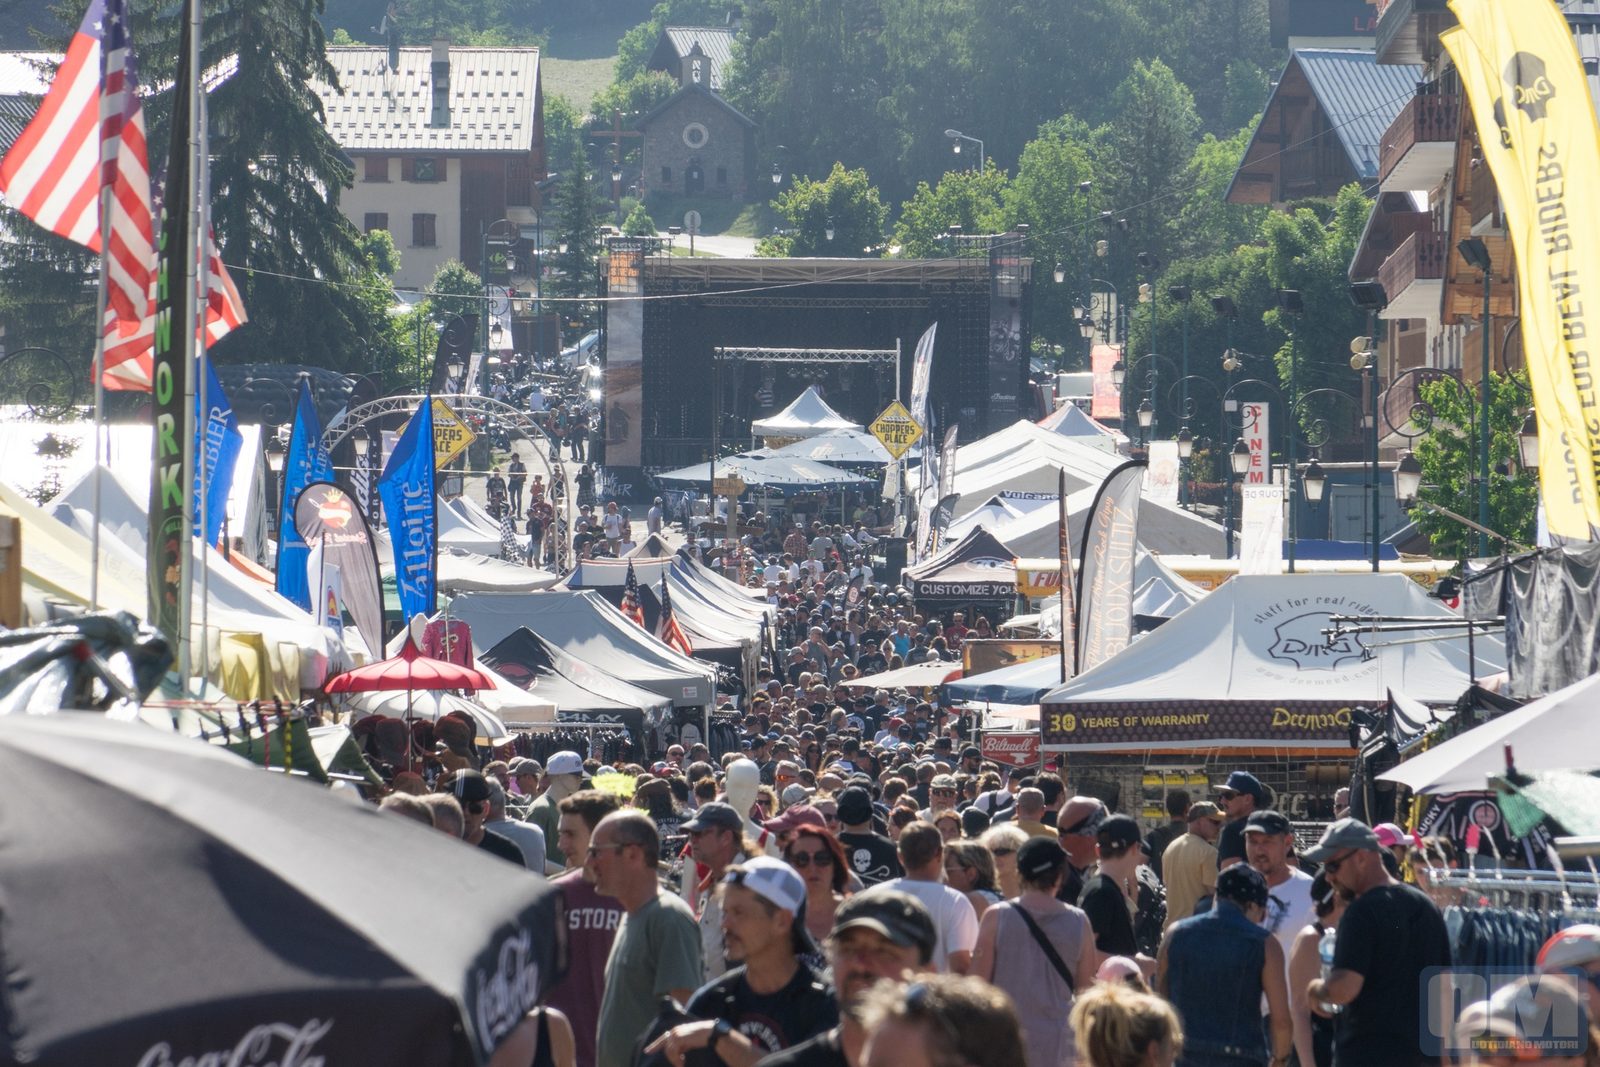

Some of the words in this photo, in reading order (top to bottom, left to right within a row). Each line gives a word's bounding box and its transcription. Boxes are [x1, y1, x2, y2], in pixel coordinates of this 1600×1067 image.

[876, 424, 914, 435] CHOPPERS
[885, 433, 907, 443] PLACE
[920, 583, 990, 596] CUSTOMIZE
[1254, 603, 1283, 624] stuff
[1287, 596, 1309, 608] for
[1315, 596, 1345, 606] real
[1104, 579, 1131, 660] BIJOUX
[1051, 713, 1076, 732] 30
[1081, 717, 1119, 728] YEARS
[1123, 716, 1138, 727] OF
[1141, 714, 1209, 726] WARRANTY
[984, 737, 1033, 752] Biltwell
